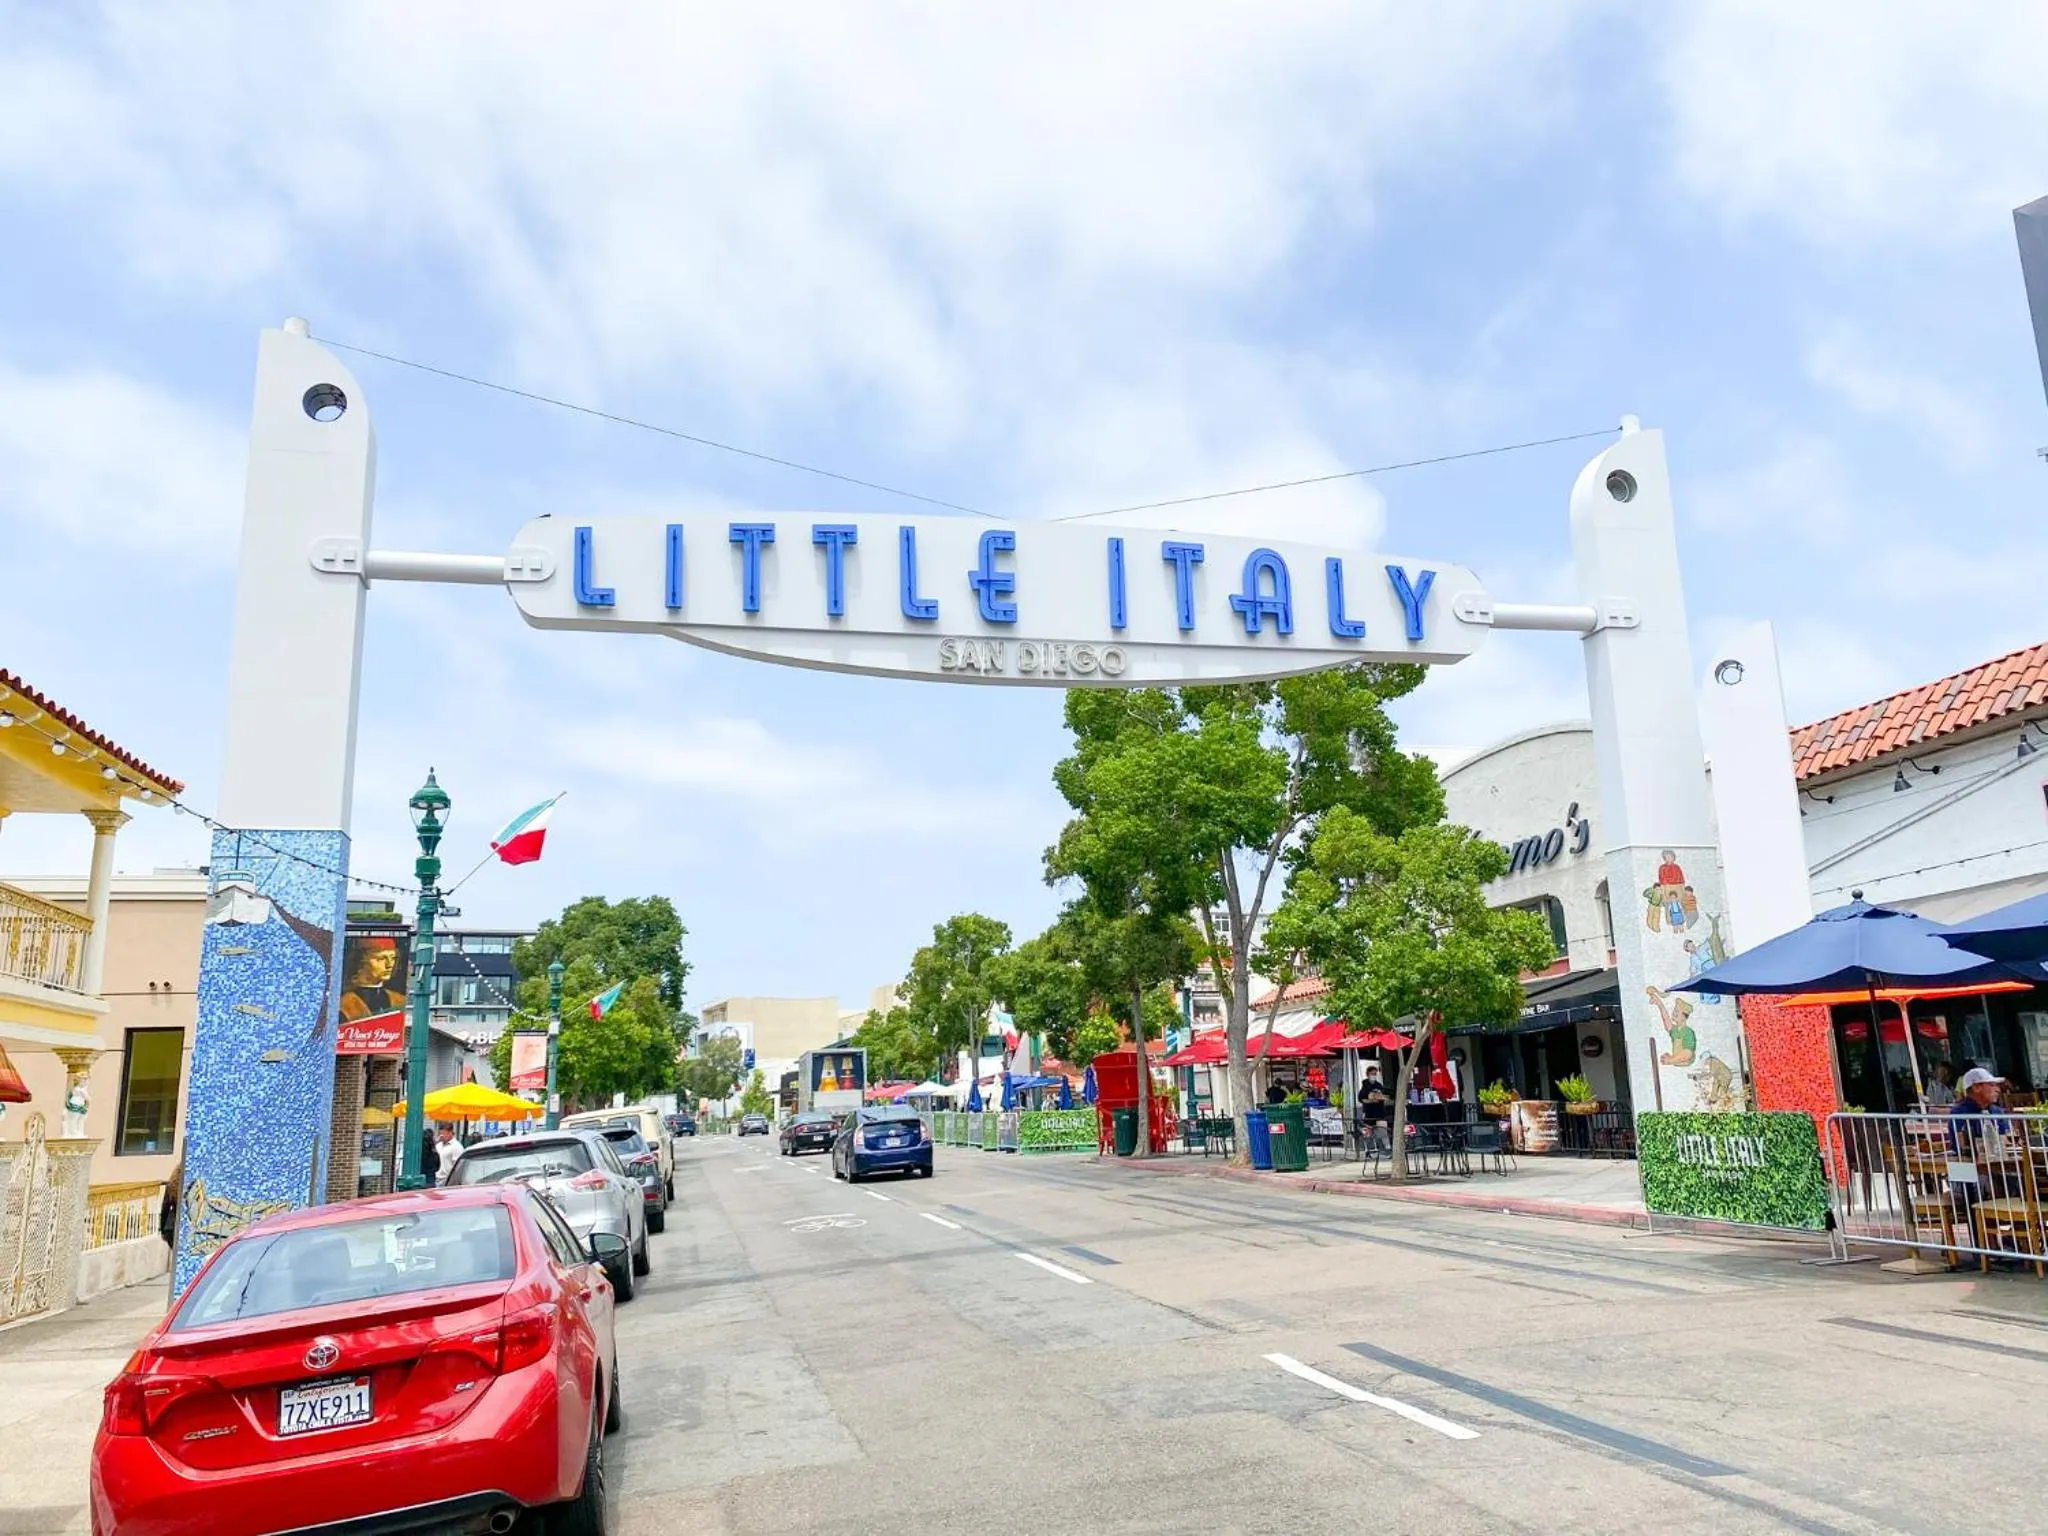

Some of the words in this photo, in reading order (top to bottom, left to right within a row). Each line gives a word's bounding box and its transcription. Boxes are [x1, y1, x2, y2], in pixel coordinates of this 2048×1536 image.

[572, 524, 1018, 624] LITTLE
[1107, 537, 1437, 642] ITALY
[940, 637, 1004, 673] SAN
[1018, 642, 1127, 677] DIEGO
[1676, 1133, 1720, 1166] LITTLE
[1724, 1135, 1766, 1168] ITALY
[284, 1391, 370, 1426] 7ZXE911
